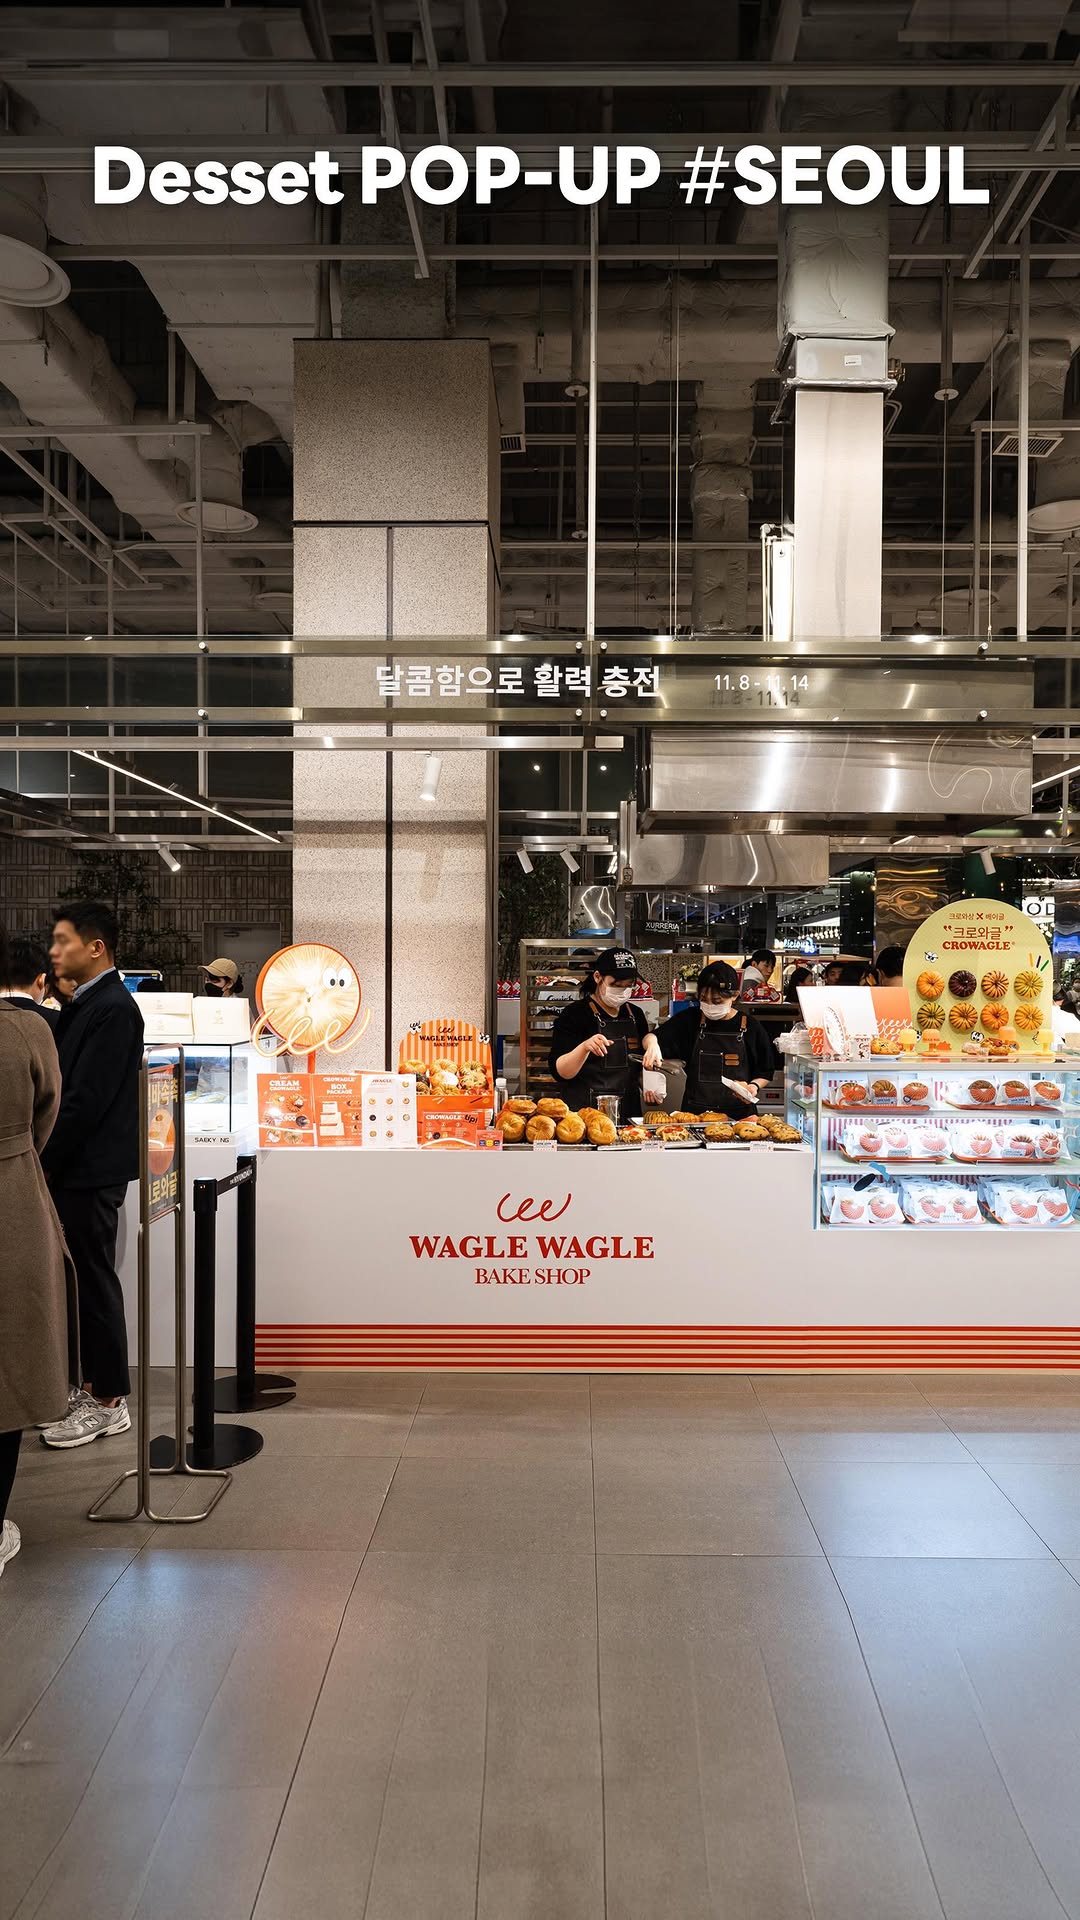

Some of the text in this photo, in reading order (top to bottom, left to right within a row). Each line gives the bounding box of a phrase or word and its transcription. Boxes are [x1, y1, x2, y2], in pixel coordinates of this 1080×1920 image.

[376, 664, 660, 697] 달콤함으로 활력 충전
[949, 912, 975, 921] 크로와상
[985, 912, 1005, 921] 베이글
[942, 940, 1011, 951] CROWAGLE
[409, 1235, 655, 1260] WAGLE WAGLE
[475, 1267, 592, 1286] BAKE SHOP
